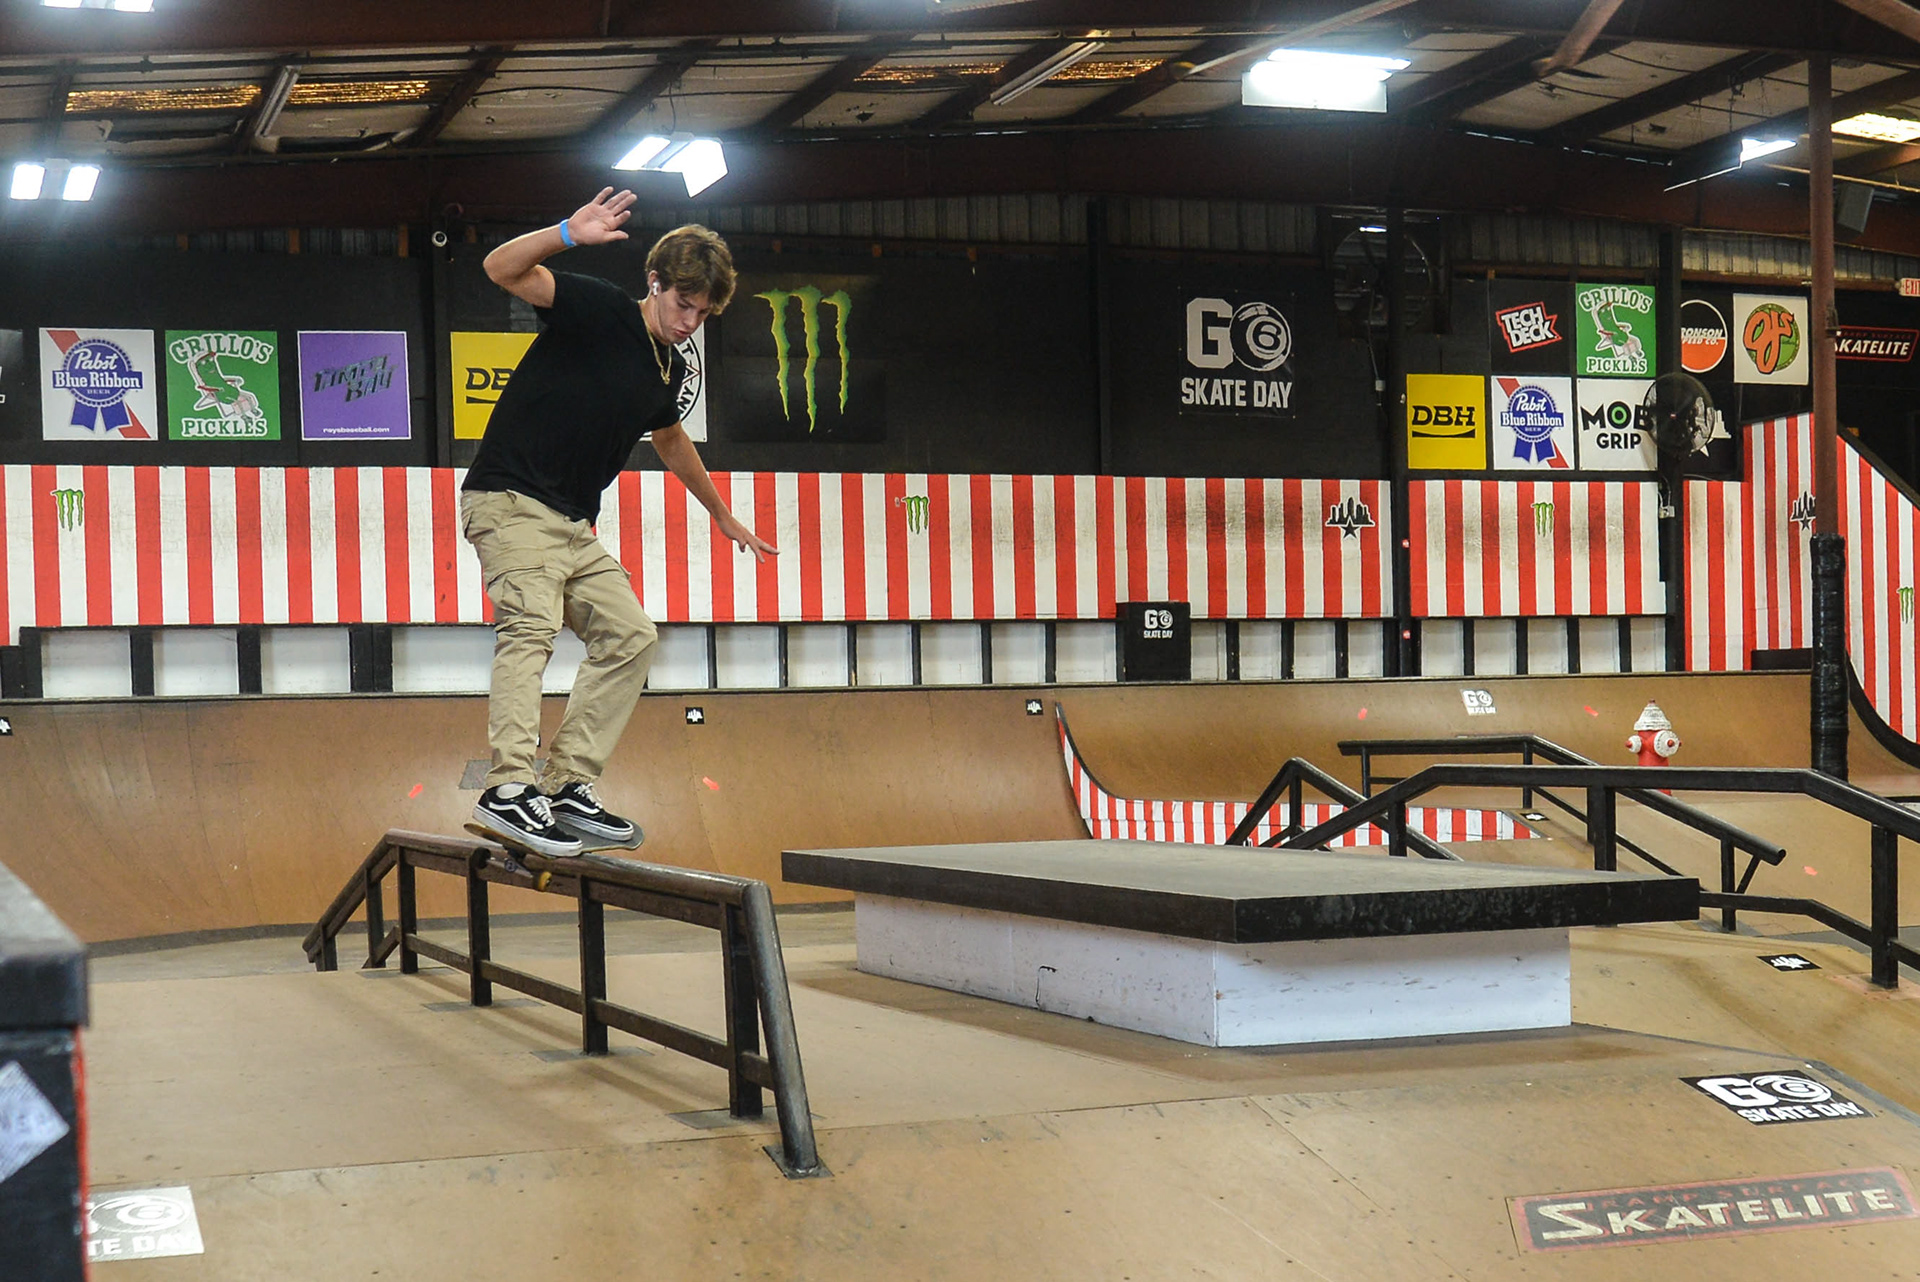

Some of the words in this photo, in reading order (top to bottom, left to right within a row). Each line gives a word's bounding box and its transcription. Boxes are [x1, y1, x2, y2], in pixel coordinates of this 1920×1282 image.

[1580, 287, 1652, 312] GRILLO'S
[1500, 306, 1545, 333] TECH
[1509, 320, 1555, 348] DECK
[1681, 327, 1724, 338] RONSON
[1681, 337, 1703, 345] PEED
[73, 348, 119, 370] Pabst
[170, 334, 273, 363] GRILLO'S
[1588, 358, 1647, 373] PICKLES
[54, 371, 88, 388] Blue
[89, 371, 141, 388] Ribbon
[465, 367, 515, 390] DB
[1181, 377, 1247, 407] SKATE
[1253, 380, 1292, 409] DAY
[1515, 393, 1547, 412] Pabst
[1411, 405, 1476, 426] DBH
[1502, 412, 1526, 426] Blue
[1526, 412, 1562, 427] Ribbon
[183, 419, 267, 436] PICKLES
[1596, 432, 1642, 449] GRIP
[1737, 1103, 1816, 1123] SKATE
[1820, 1100, 1865, 1119] DAY
[1537, 1188, 1896, 1240] SKATELITE
